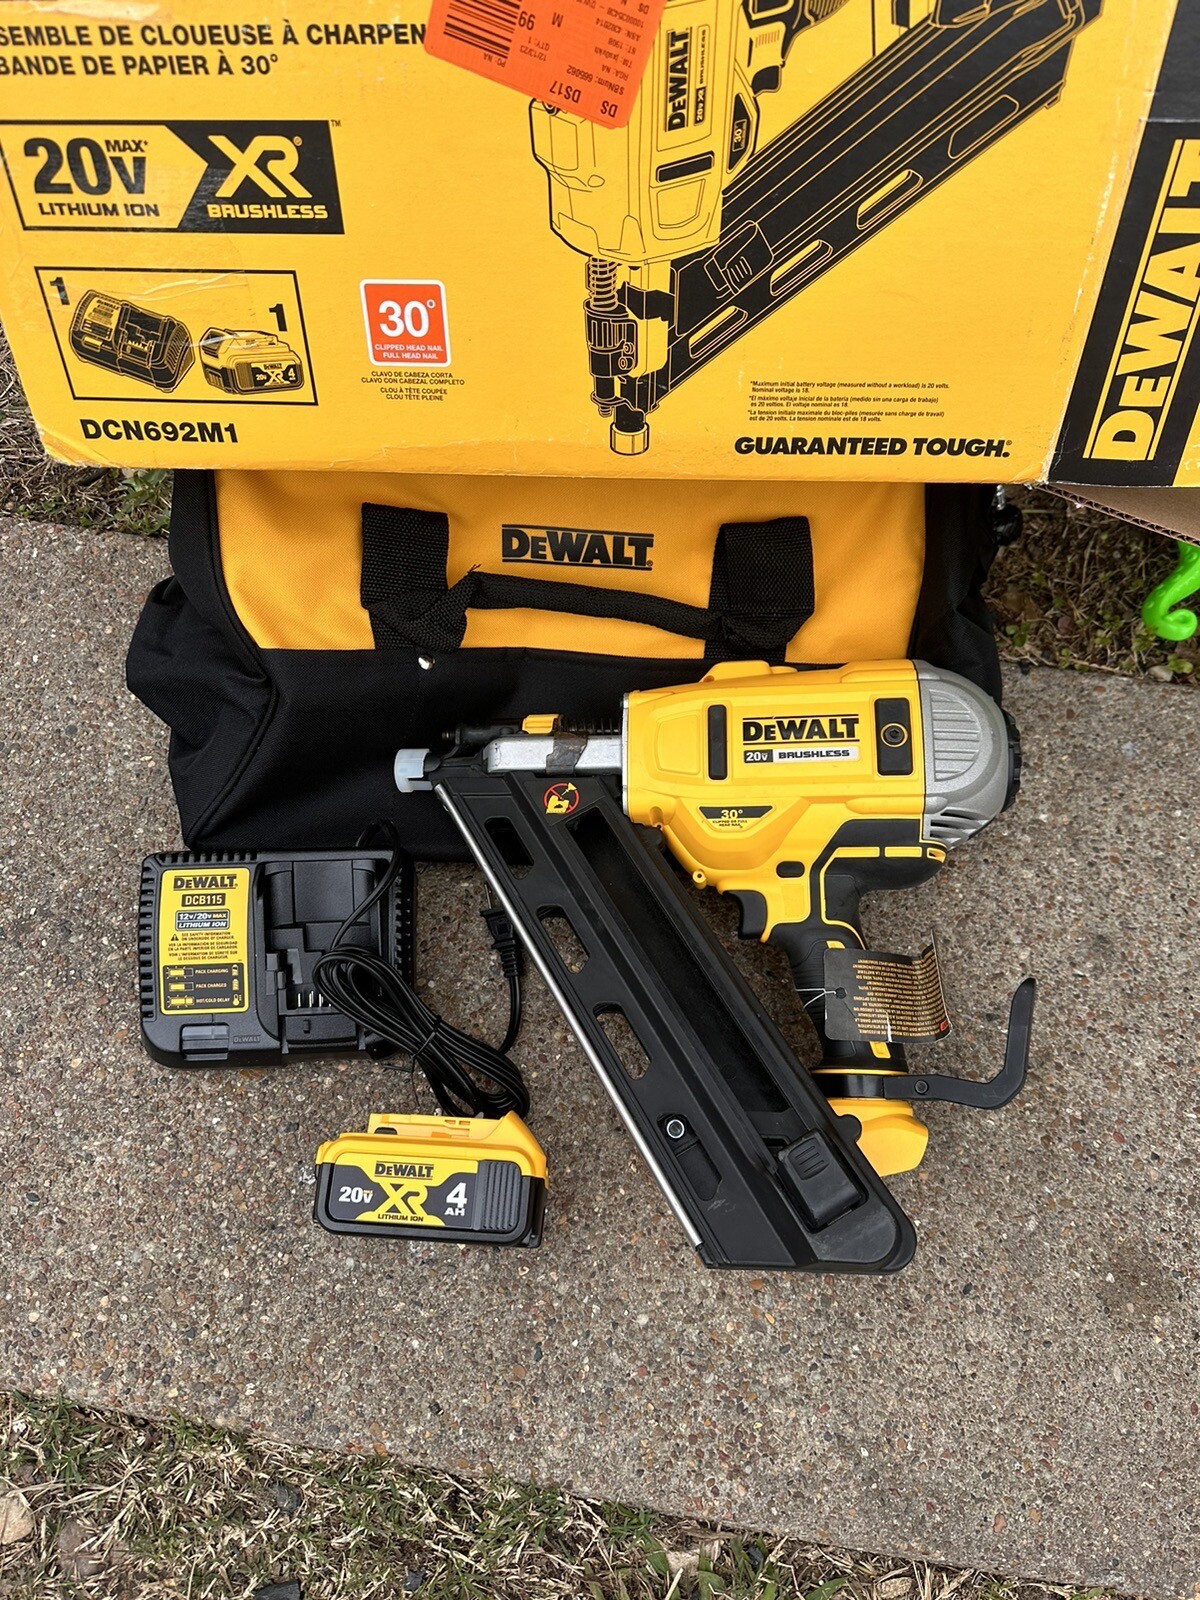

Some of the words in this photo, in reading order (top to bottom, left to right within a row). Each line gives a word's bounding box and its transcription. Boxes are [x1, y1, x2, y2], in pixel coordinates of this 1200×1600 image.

[518, 10, 536, 31] 99
[551, 11, 564, 28] M
[0, 25, 93, 46] SEMBLE
[98, 25, 133, 46] DE
[141, 24, 273, 46] CLOUEUSE
[283, 19, 299, 45] À
[307, 24, 427, 45] CHARPEN
[0, 55, 76, 75] BANDE
[81, 55, 115, 75] DE
[123, 55, 209, 75] PAPIER
[217, 50, 234, 74] À
[241, 54, 279, 75] 30°
[549, 80, 582, 104] DS17
[667, 30, 691, 132] DEWALT
[599, 100, 619, 119] DS
[24, 137, 146, 195] 20V
[208, 134, 313, 198] XR
[38, 202, 120, 216] LITHIUM
[124, 204, 160, 217] ION
[207, 204, 329, 219] BRUSHLESS
[49, 276, 70, 306] 1
[269, 303, 288, 332] 1
[378, 299, 436, 338] 30°
[80, 419, 239, 443] DCN692M1
[734, 437, 907, 455] GUARANTEED
[502, 529, 653, 566] DEWALT
[742, 718, 859, 741] DEWALT
[778, 750, 850, 759] BRUSHLESS
[721, 809, 743, 819] 30°
[173, 875, 237, 889] DEWALT
[185, 895, 223, 905] DCB115
[375, 1163, 434, 1178] DEWALT
[446, 1182, 467, 1208] 4
[378, 1213, 408, 1221] LITHIUM
[444, 1207, 465, 1216] AH
